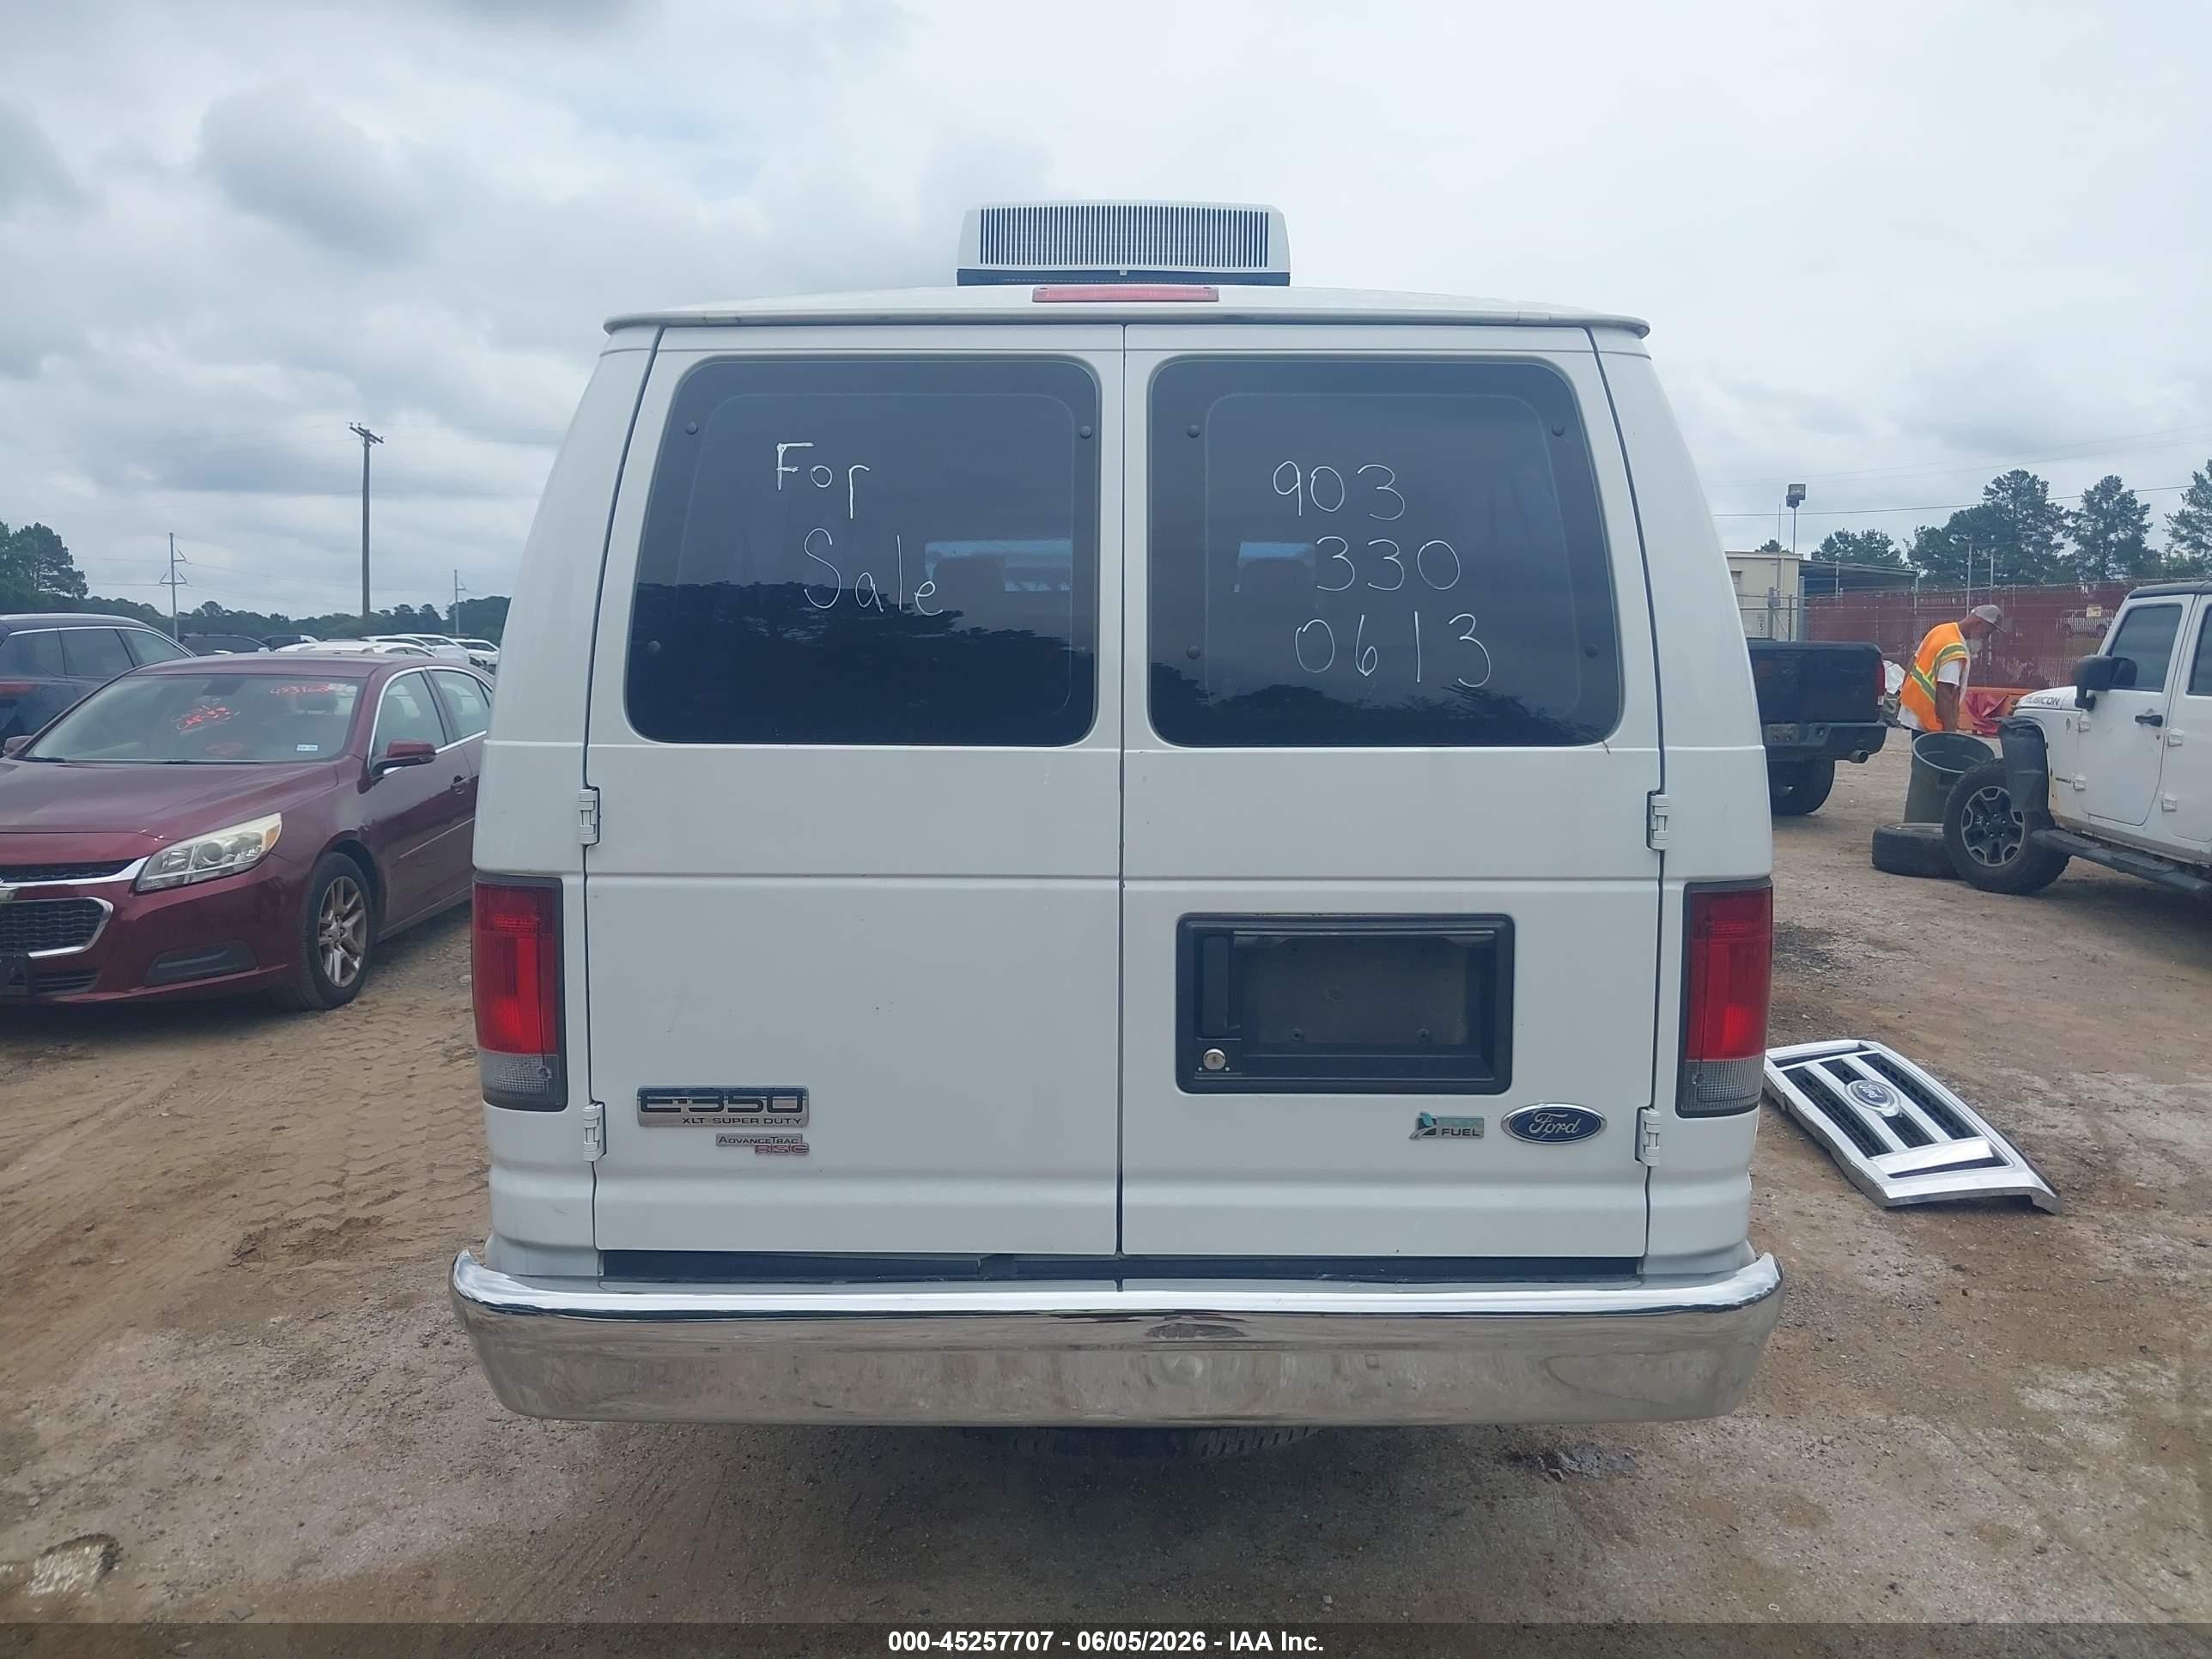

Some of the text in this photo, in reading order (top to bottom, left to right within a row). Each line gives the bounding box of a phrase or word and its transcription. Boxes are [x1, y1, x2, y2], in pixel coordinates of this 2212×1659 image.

[776, 442, 871, 519] For
[1273, 460, 1405, 520] 903
[804, 527, 943, 616] Sale
[1316, 536, 1461, 591] 330
[1295, 611, 1491, 688] 0613
[640, 1088, 805, 1114] E-350
[1528, 1111, 1582, 1139] Ford
[754, 1143, 810, 1155] RSC
[1441, 1127, 1480, 1137] FUEL
